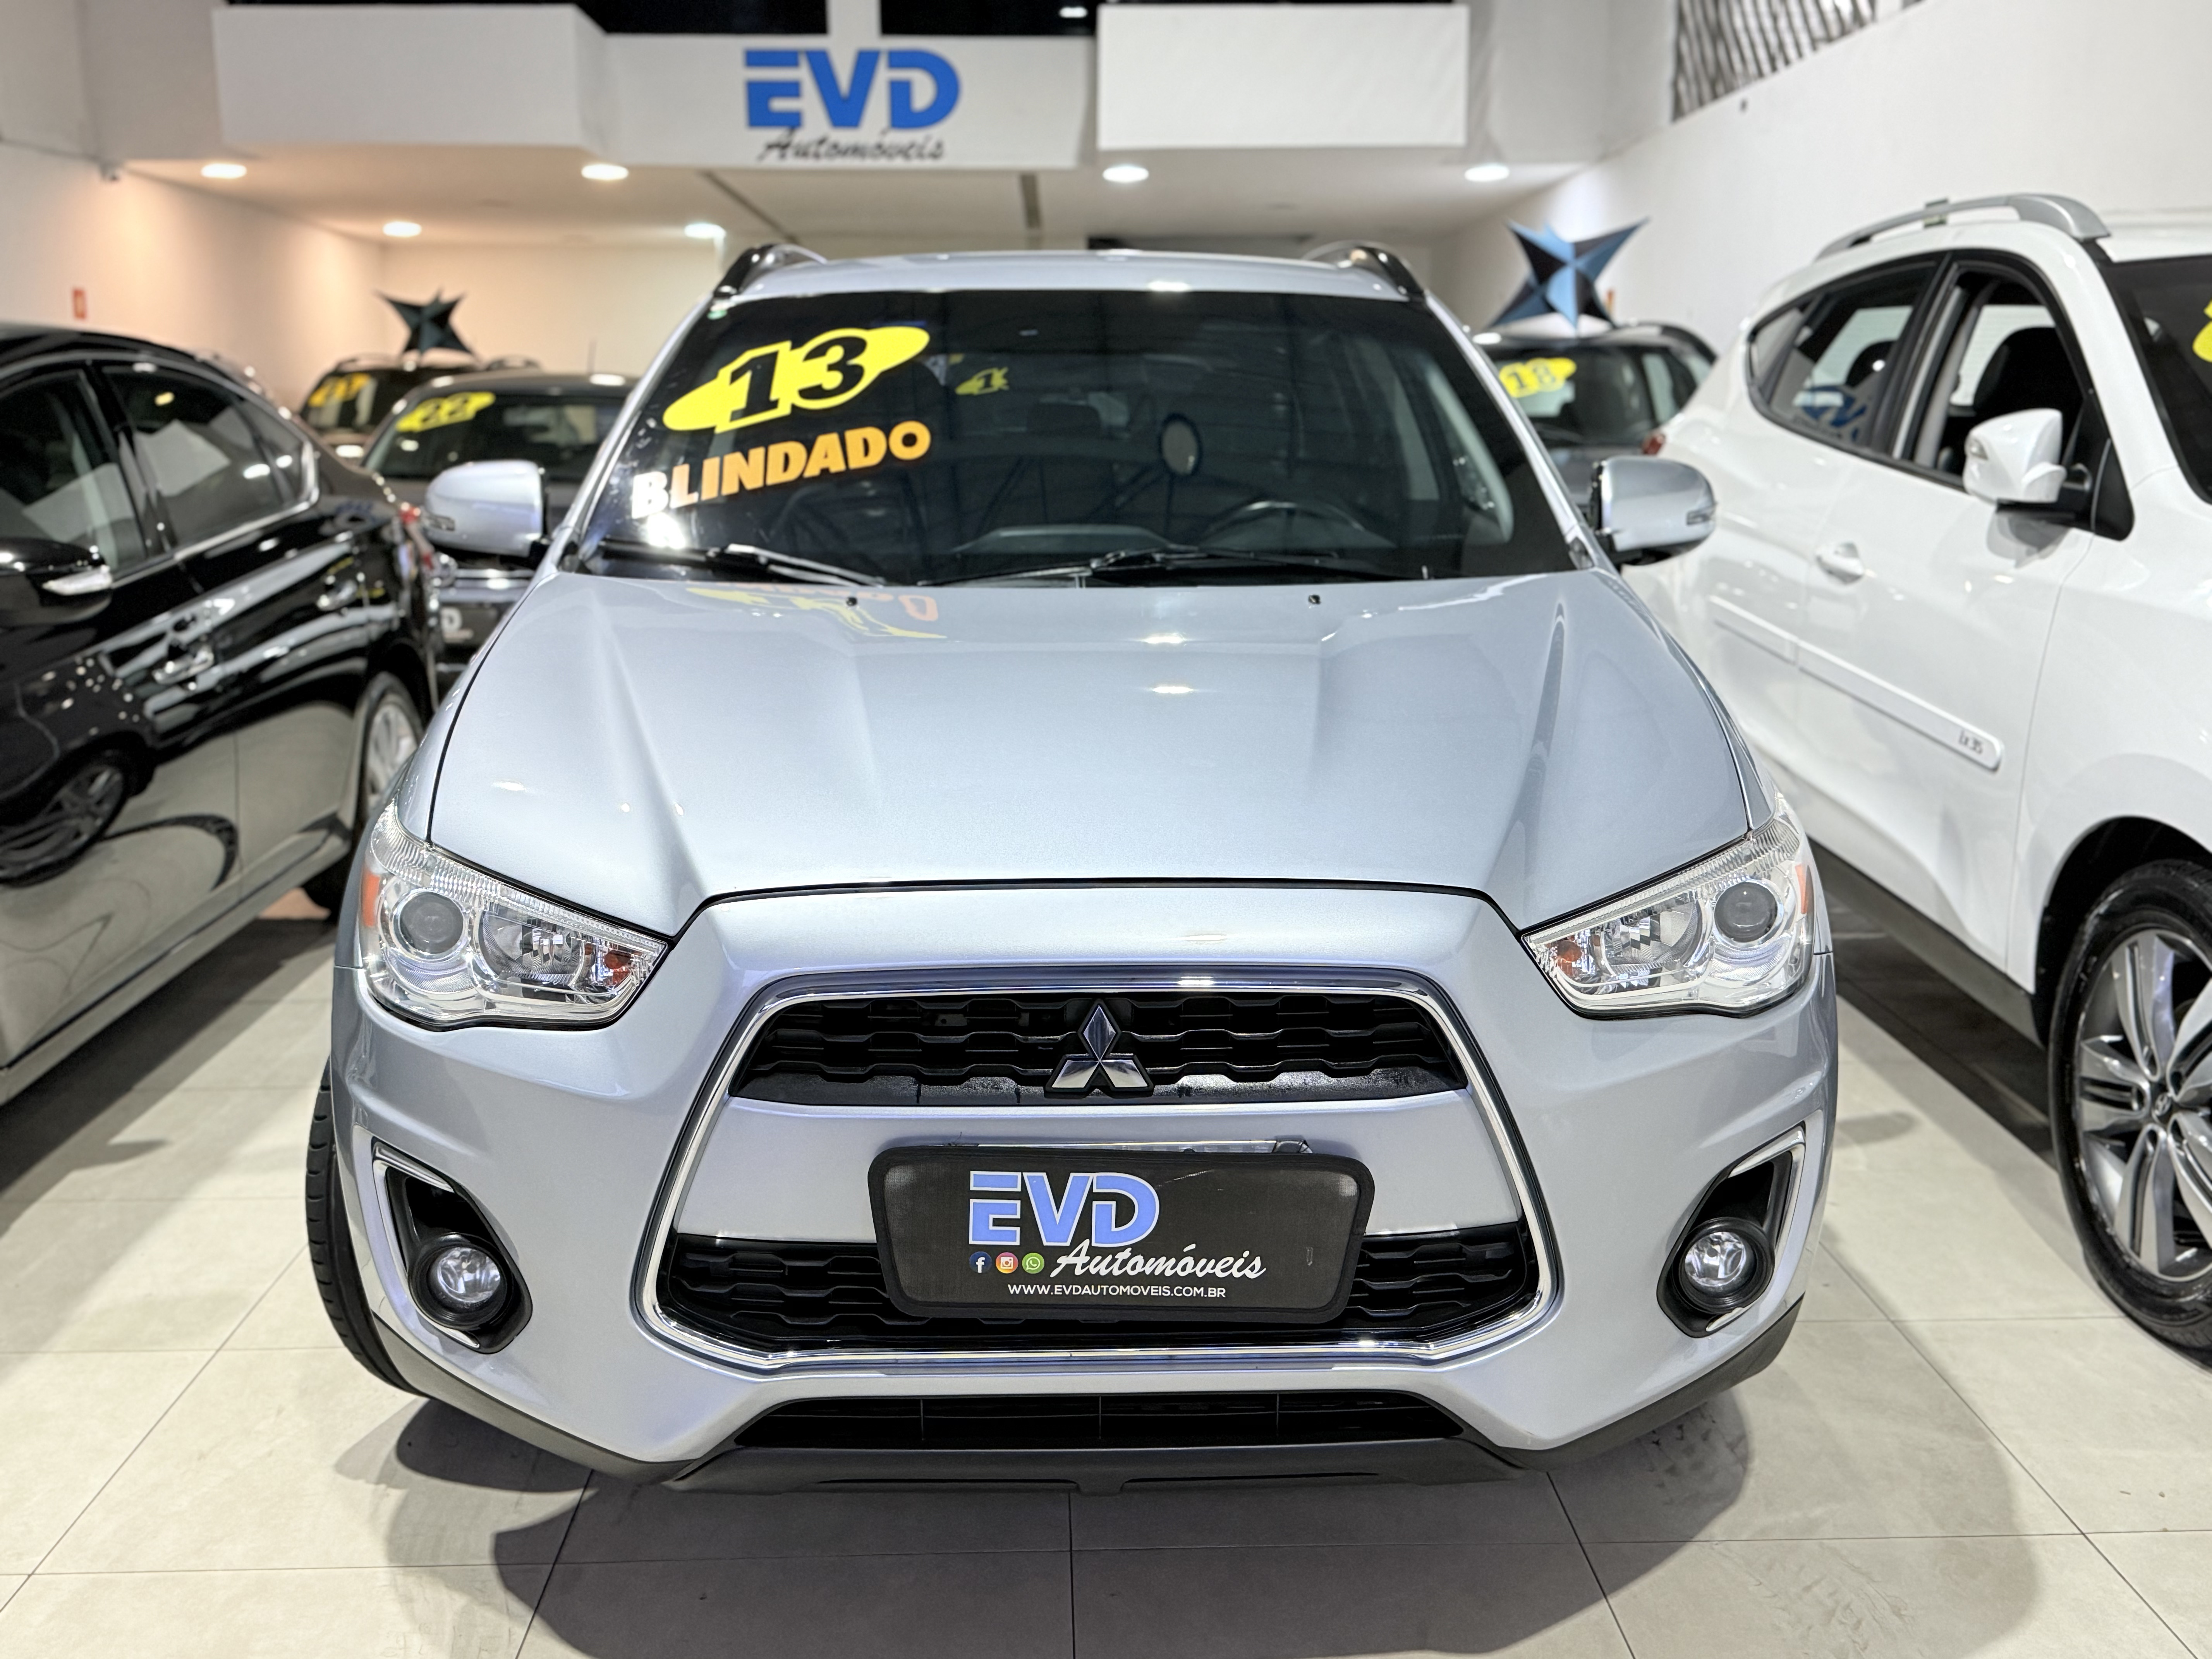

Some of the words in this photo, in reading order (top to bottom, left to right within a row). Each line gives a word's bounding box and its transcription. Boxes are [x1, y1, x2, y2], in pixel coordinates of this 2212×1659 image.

[744, 48, 961, 129] EVD
[729, 335, 868, 422] 13
[631, 421, 931, 520] BLINDADO
[969, 1170, 1160, 1248] EVD
[1008, 1284, 1226, 1298] WWW.EVDAUTOMOVEIS.COM.BR
[1049, 1238, 1267, 1279] Automóveis
